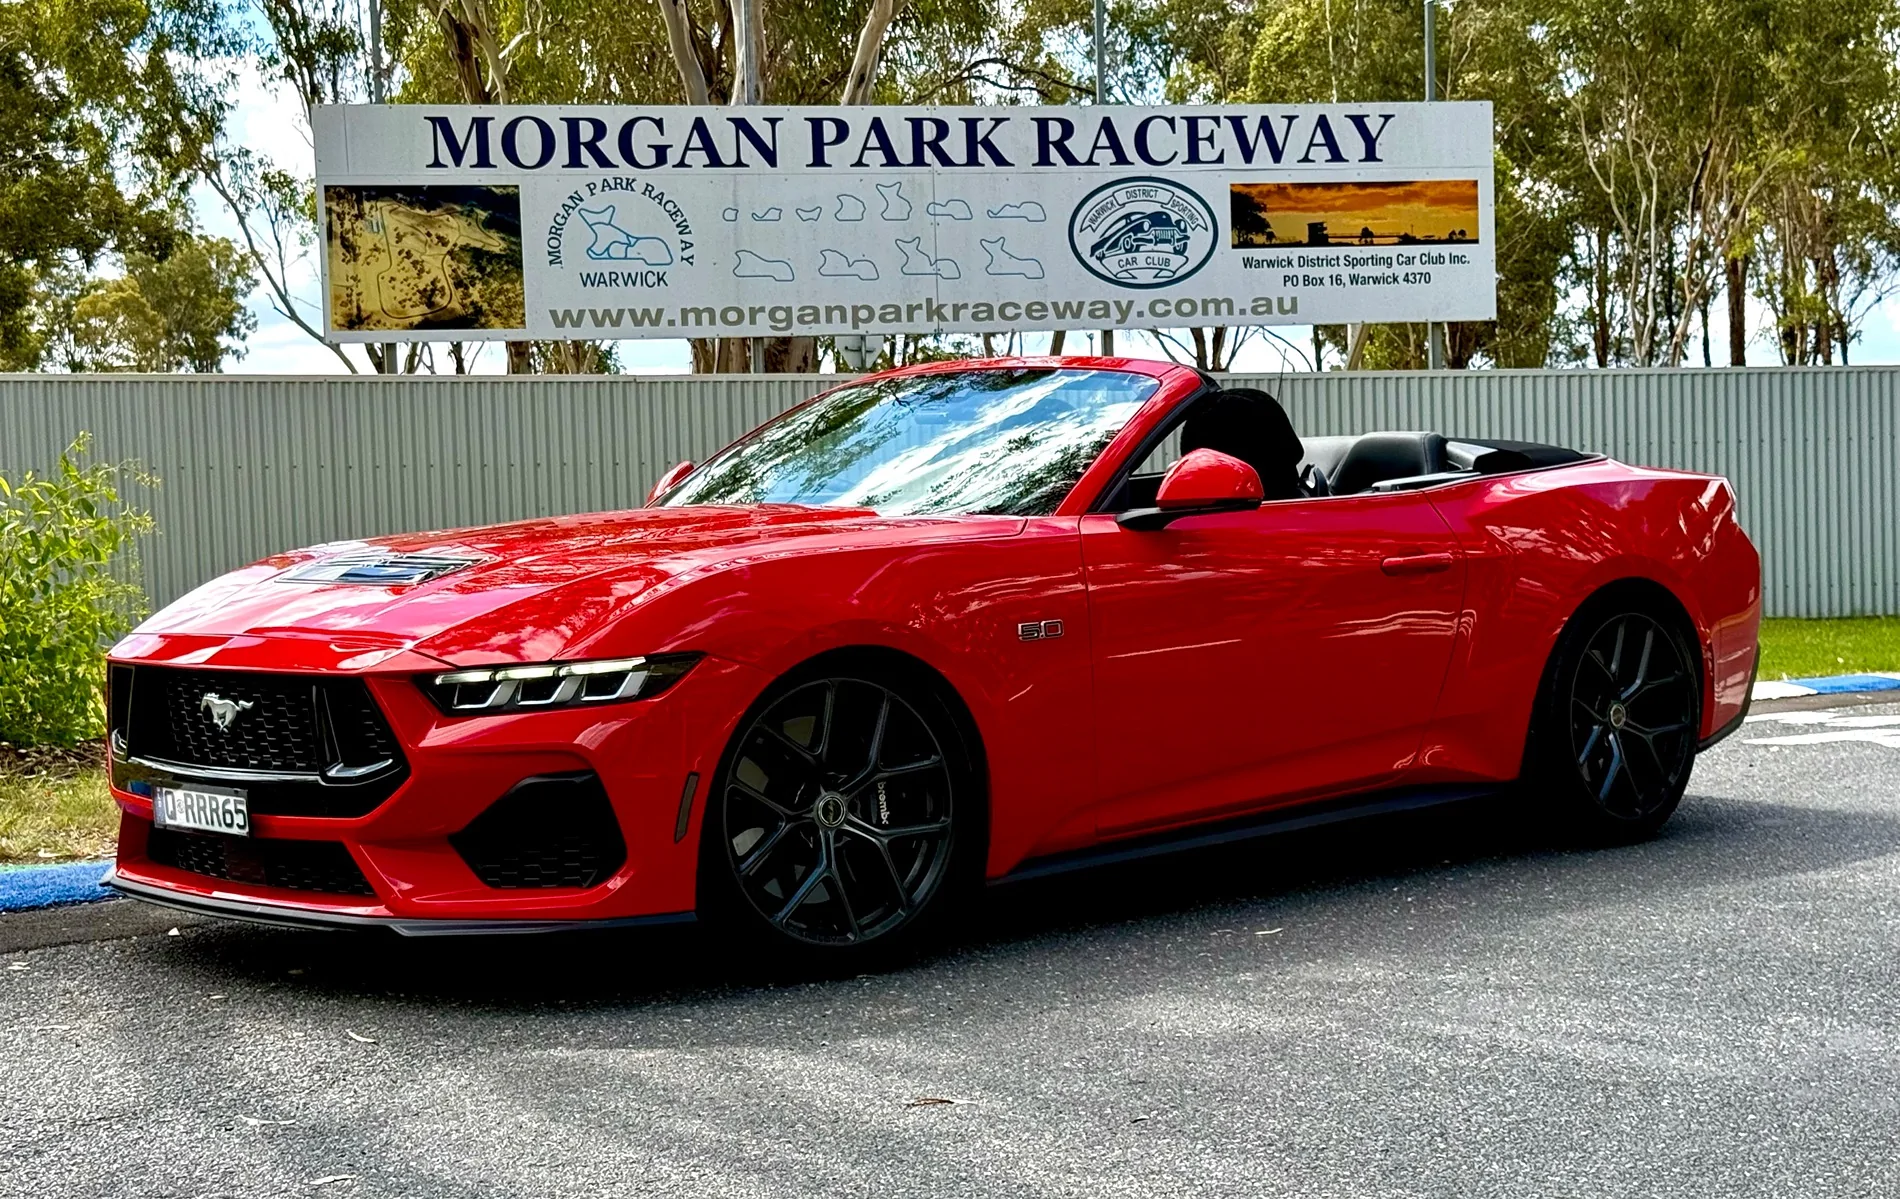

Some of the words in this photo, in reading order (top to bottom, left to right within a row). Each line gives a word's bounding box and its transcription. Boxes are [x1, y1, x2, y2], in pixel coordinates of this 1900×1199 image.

[424, 116, 784, 169] MORGAN
[804, 117, 1015, 168] PARK
[1031, 114, 1395, 167] RACEWAY
[1088, 199, 1116, 225] WARWICK
[1125, 188, 1159, 200] DISTRICT
[1170, 199, 1199, 225] SPORTING
[547, 190, 584, 267] MORGAN
[585, 177, 637, 197] PARK
[641, 183, 695, 267] RACEWAY
[1118, 256, 1138, 269] CAR
[1145, 256, 1171, 267] CLUB
[1242, 256, 1294, 269] Warwick
[1297, 255, 1340, 268] District
[1343, 254, 1393, 269] Sporting
[1396, 253, 1416, 266] Car
[1419, 251, 1445, 265] Club
[1449, 252, 1470, 264] Inc.
[579, 270, 668, 288] WARWICK
[1283, 274, 1299, 287] PO
[1302, 274, 1325, 287] Box
[1329, 274, 1346, 288] 16,
[1348, 272, 1400, 286] Warwick
[1403, 272, 1431, 284] 4370
[549, 296, 1299, 331] www.morganparkraceway.com.au
[1018, 619, 1064, 641] 5.0
